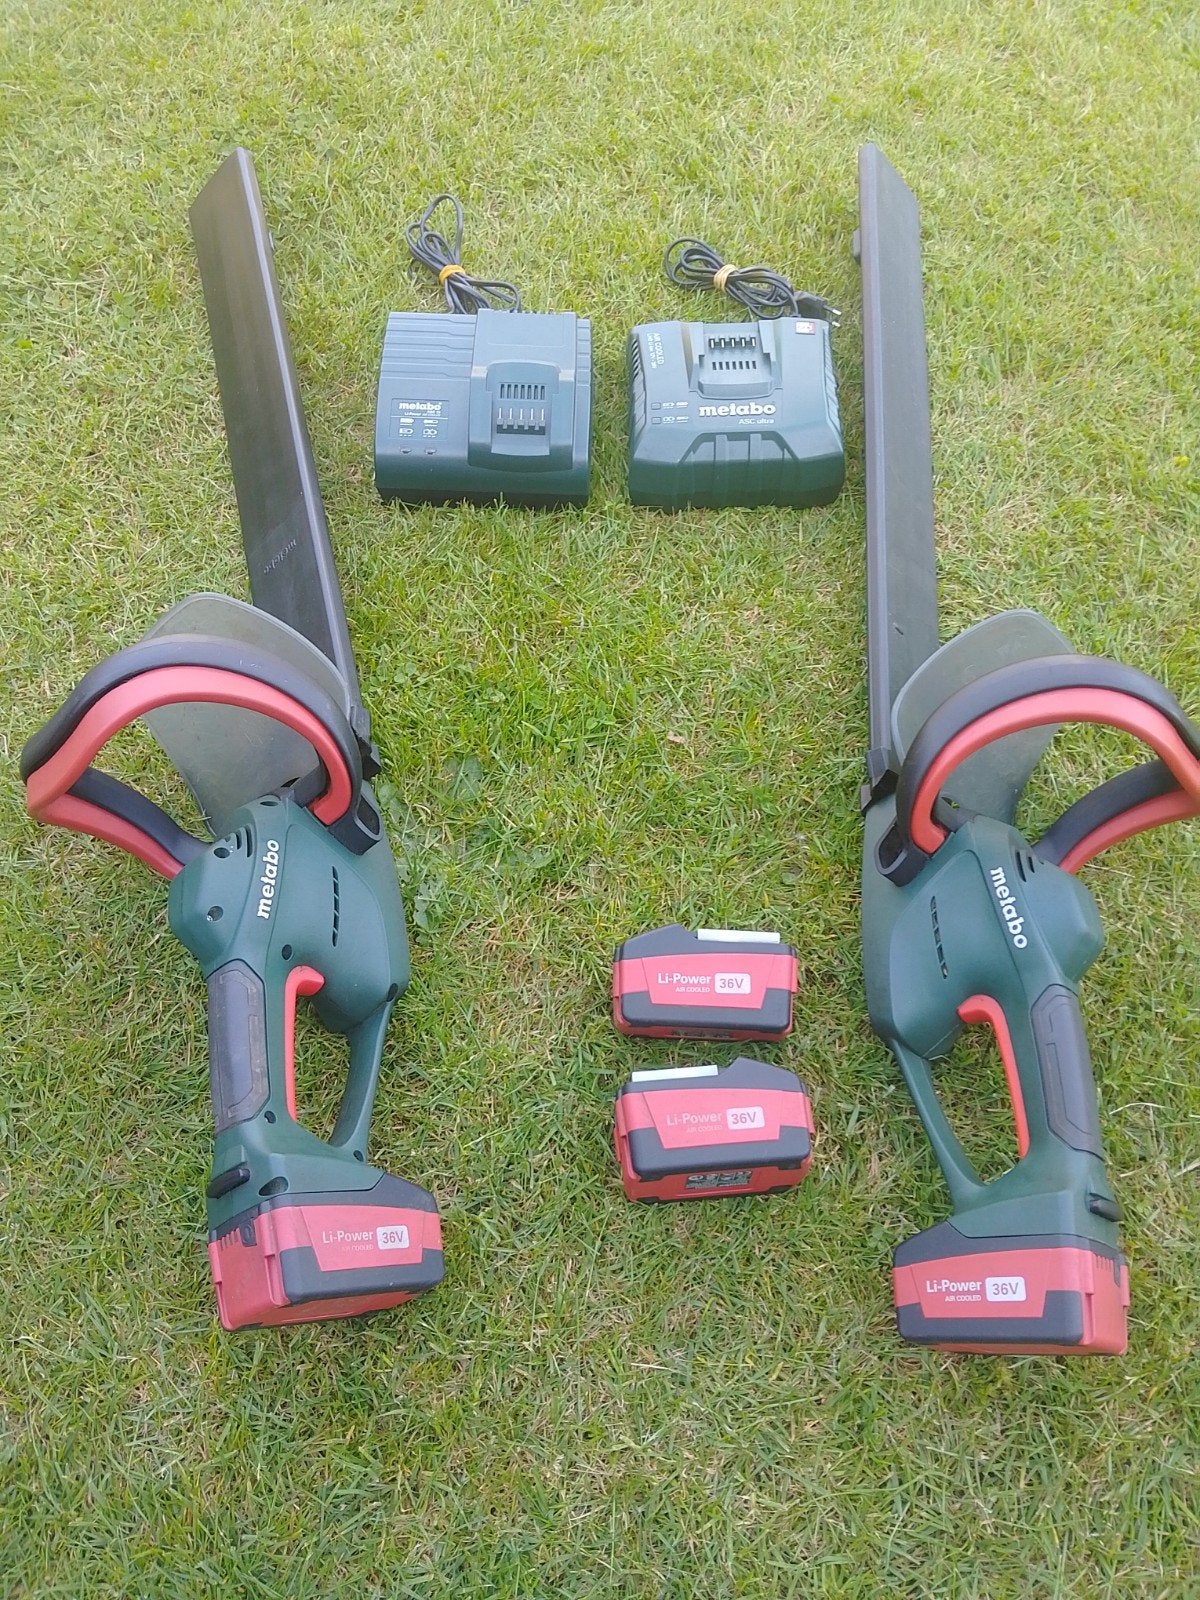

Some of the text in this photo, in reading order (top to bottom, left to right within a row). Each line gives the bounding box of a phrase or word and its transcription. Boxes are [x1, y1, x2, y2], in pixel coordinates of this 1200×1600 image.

[399, 402, 442, 410] metabo
[699, 402, 776, 416] metabo
[257, 839, 280, 920] metabo
[990, 866, 1028, 949] metabo
[658, 973, 745, 989] Li-Power 36V
[667, 1112, 757, 1126] Li-Power 36V
[322, 1230, 404, 1244] Li-Power 36V
[926, 1279, 1019, 1296] Li-Power 36V
